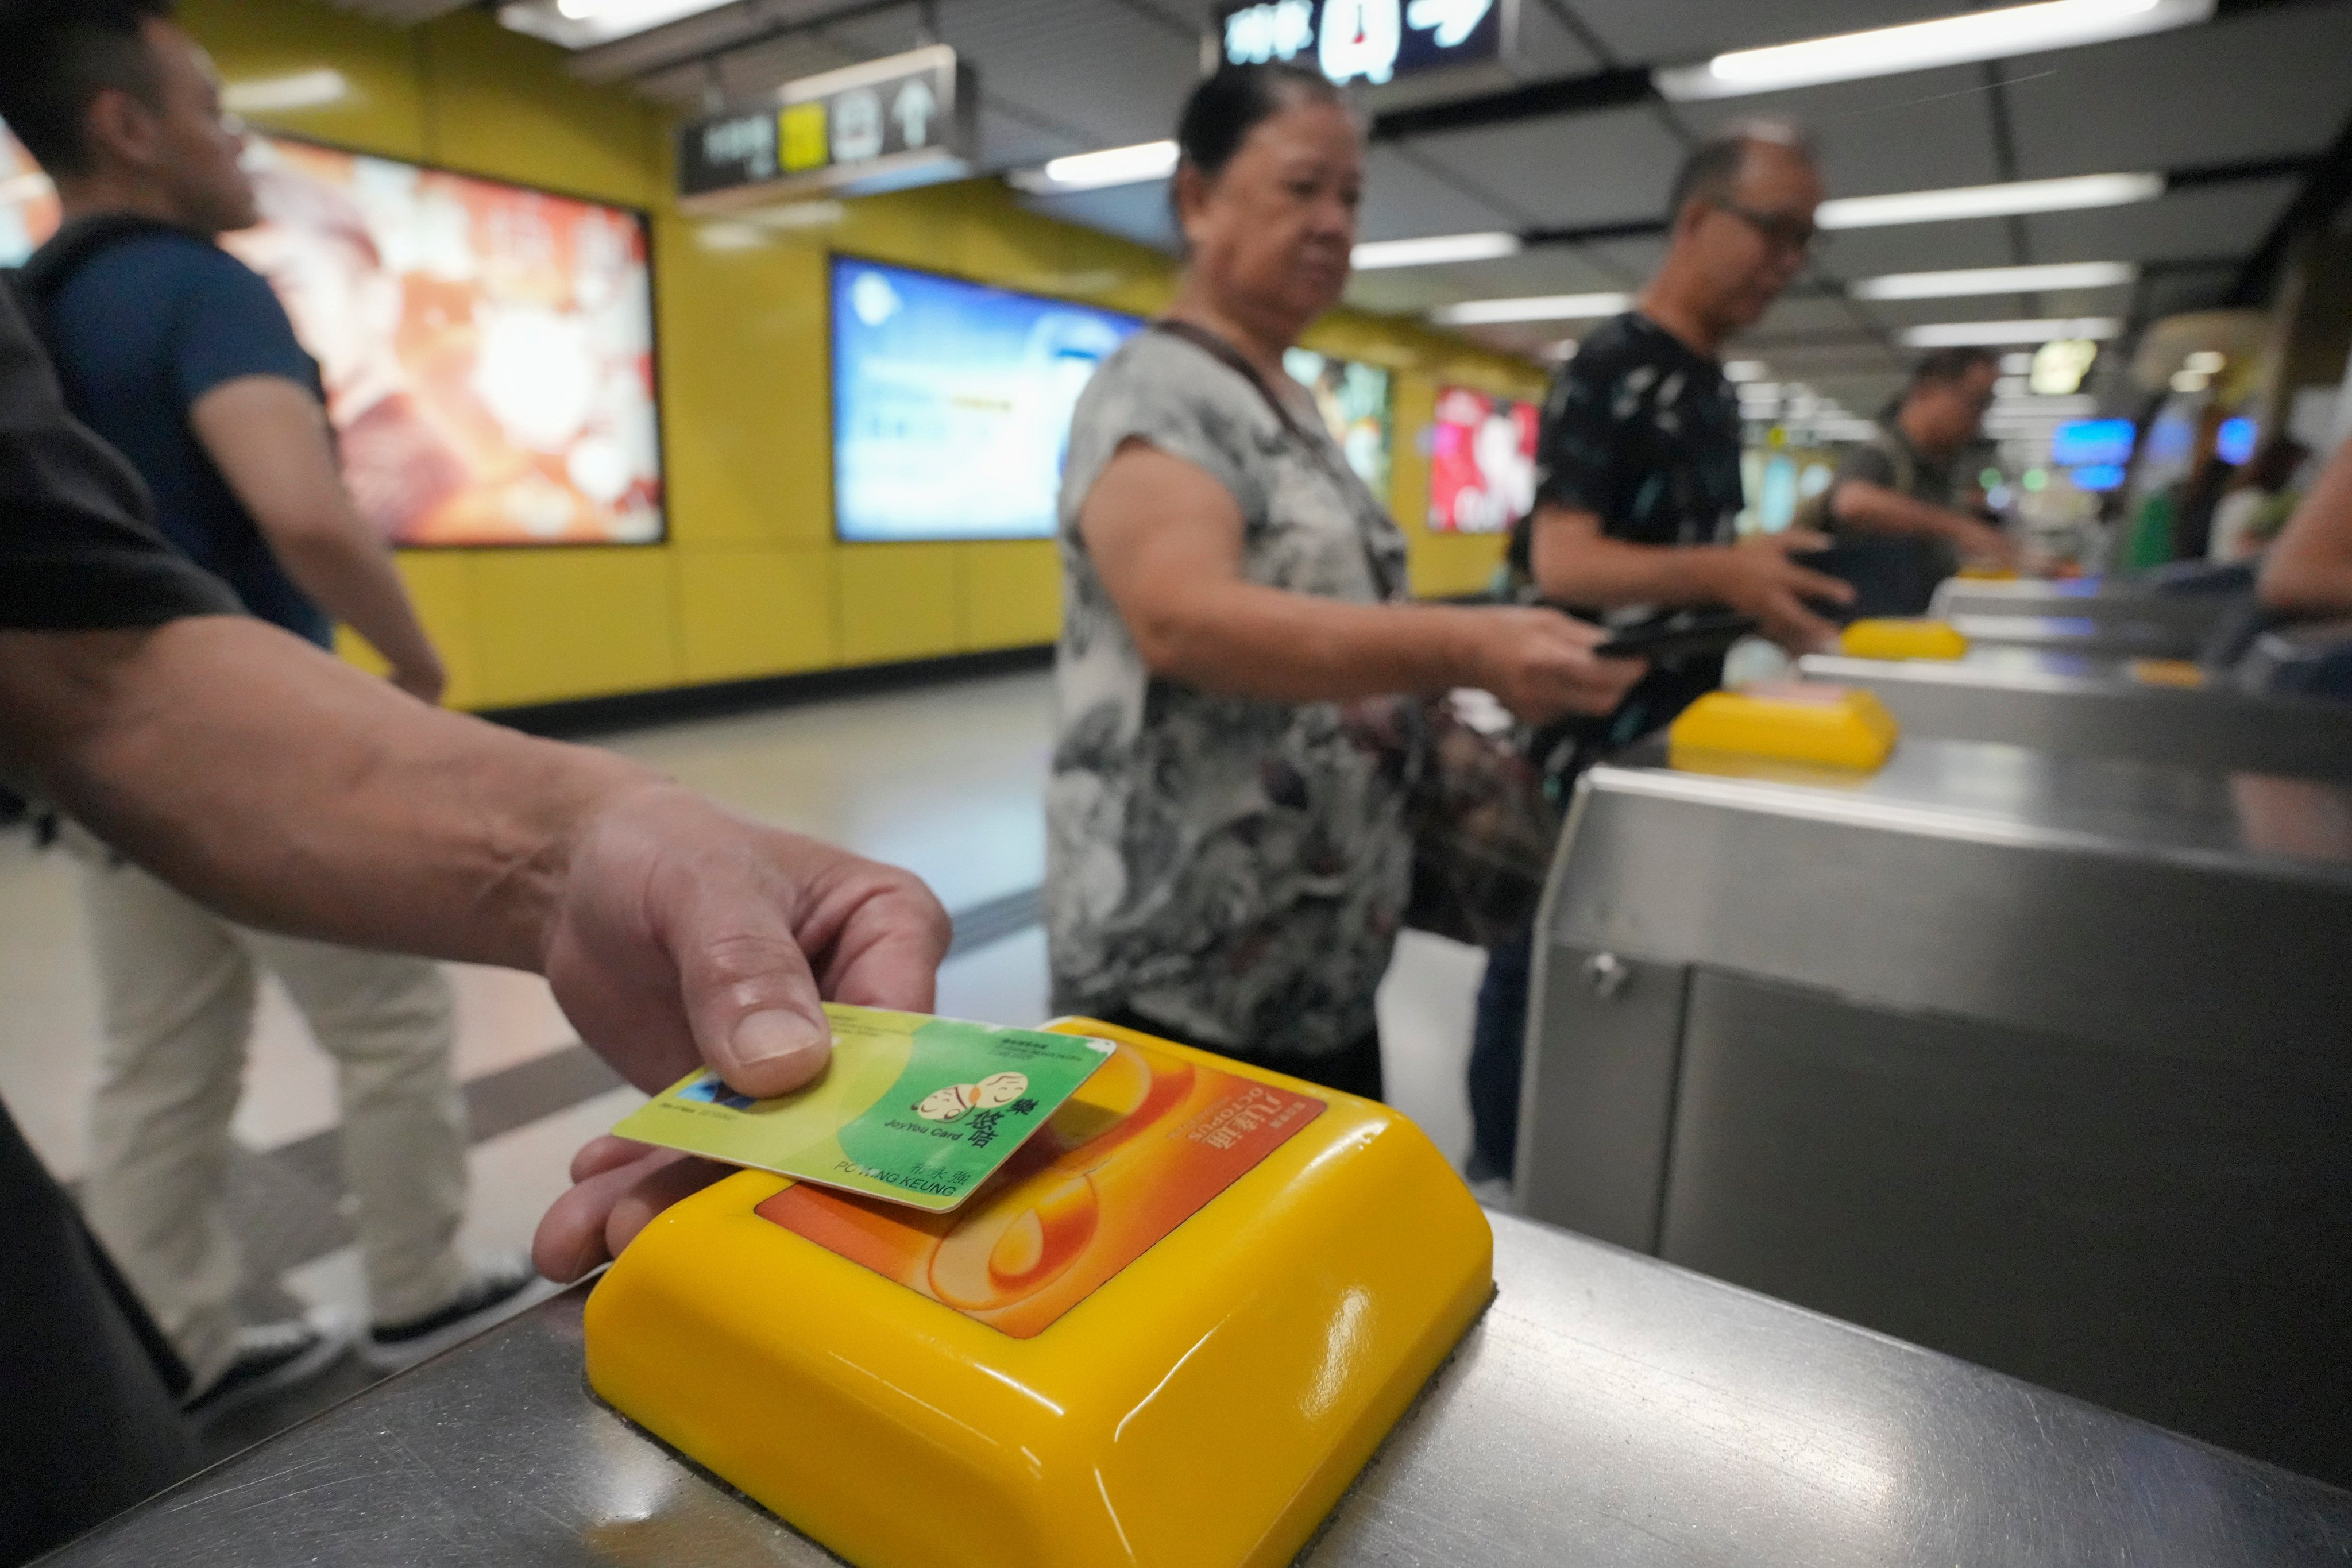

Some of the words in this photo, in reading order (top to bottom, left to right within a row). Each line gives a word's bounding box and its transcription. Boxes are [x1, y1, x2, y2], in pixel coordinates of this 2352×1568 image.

[884, 1119, 928, 1134] JoyYou
[930, 1127, 963, 1141] Card
[1188, 1087, 1264, 1140] OCTOPUS
[1202, 1094, 1282, 1149] 八達通
[899, 1176, 956, 1196] KEUNG
